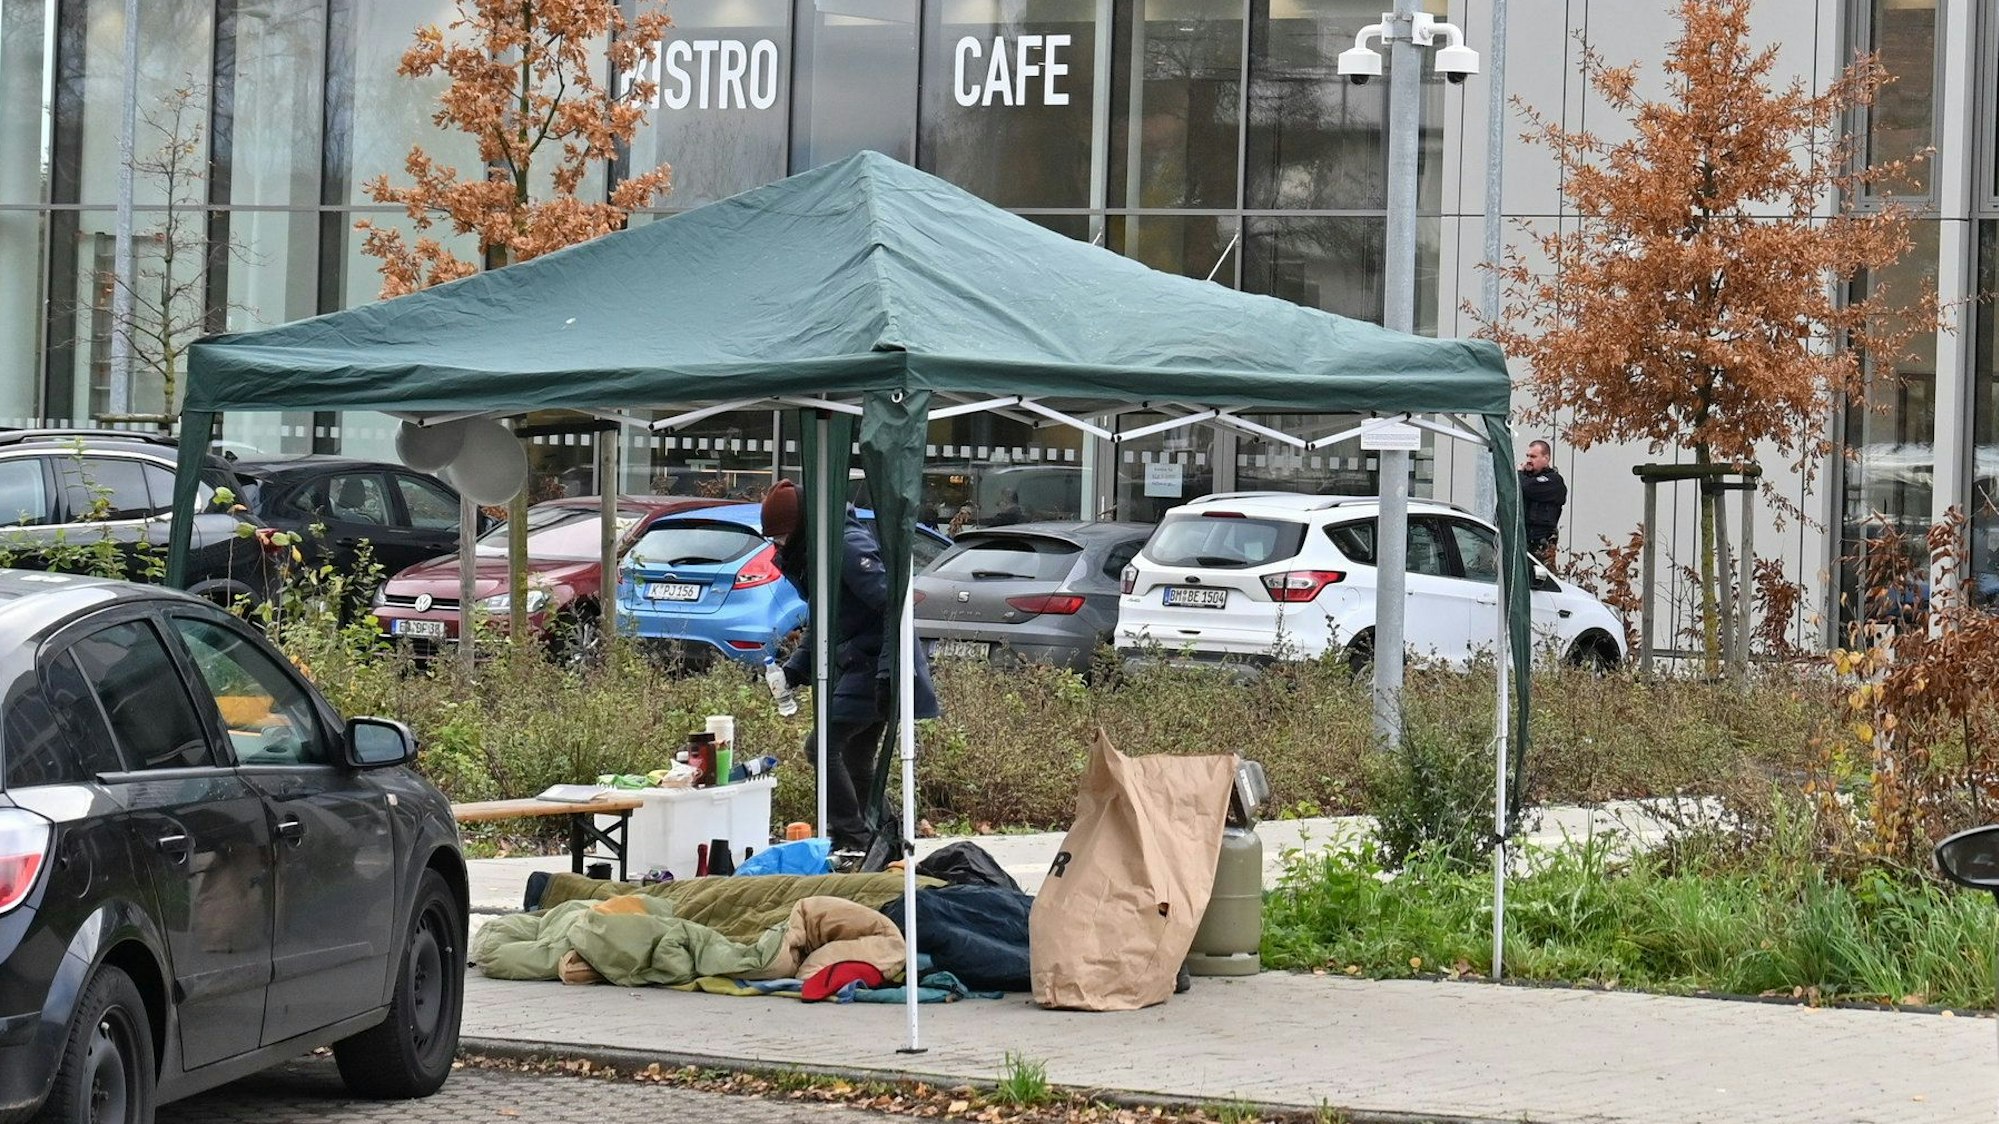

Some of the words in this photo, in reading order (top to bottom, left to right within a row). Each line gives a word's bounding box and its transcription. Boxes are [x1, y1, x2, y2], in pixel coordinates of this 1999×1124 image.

[954, 35, 1071, 106] CAFE
[651, 585, 660, 595] K
[677, 586, 694, 597] 156
[1170, 589, 1183, 602] BM
[1188, 590, 1200, 602] BE
[1201, 591, 1224, 604] 1504
